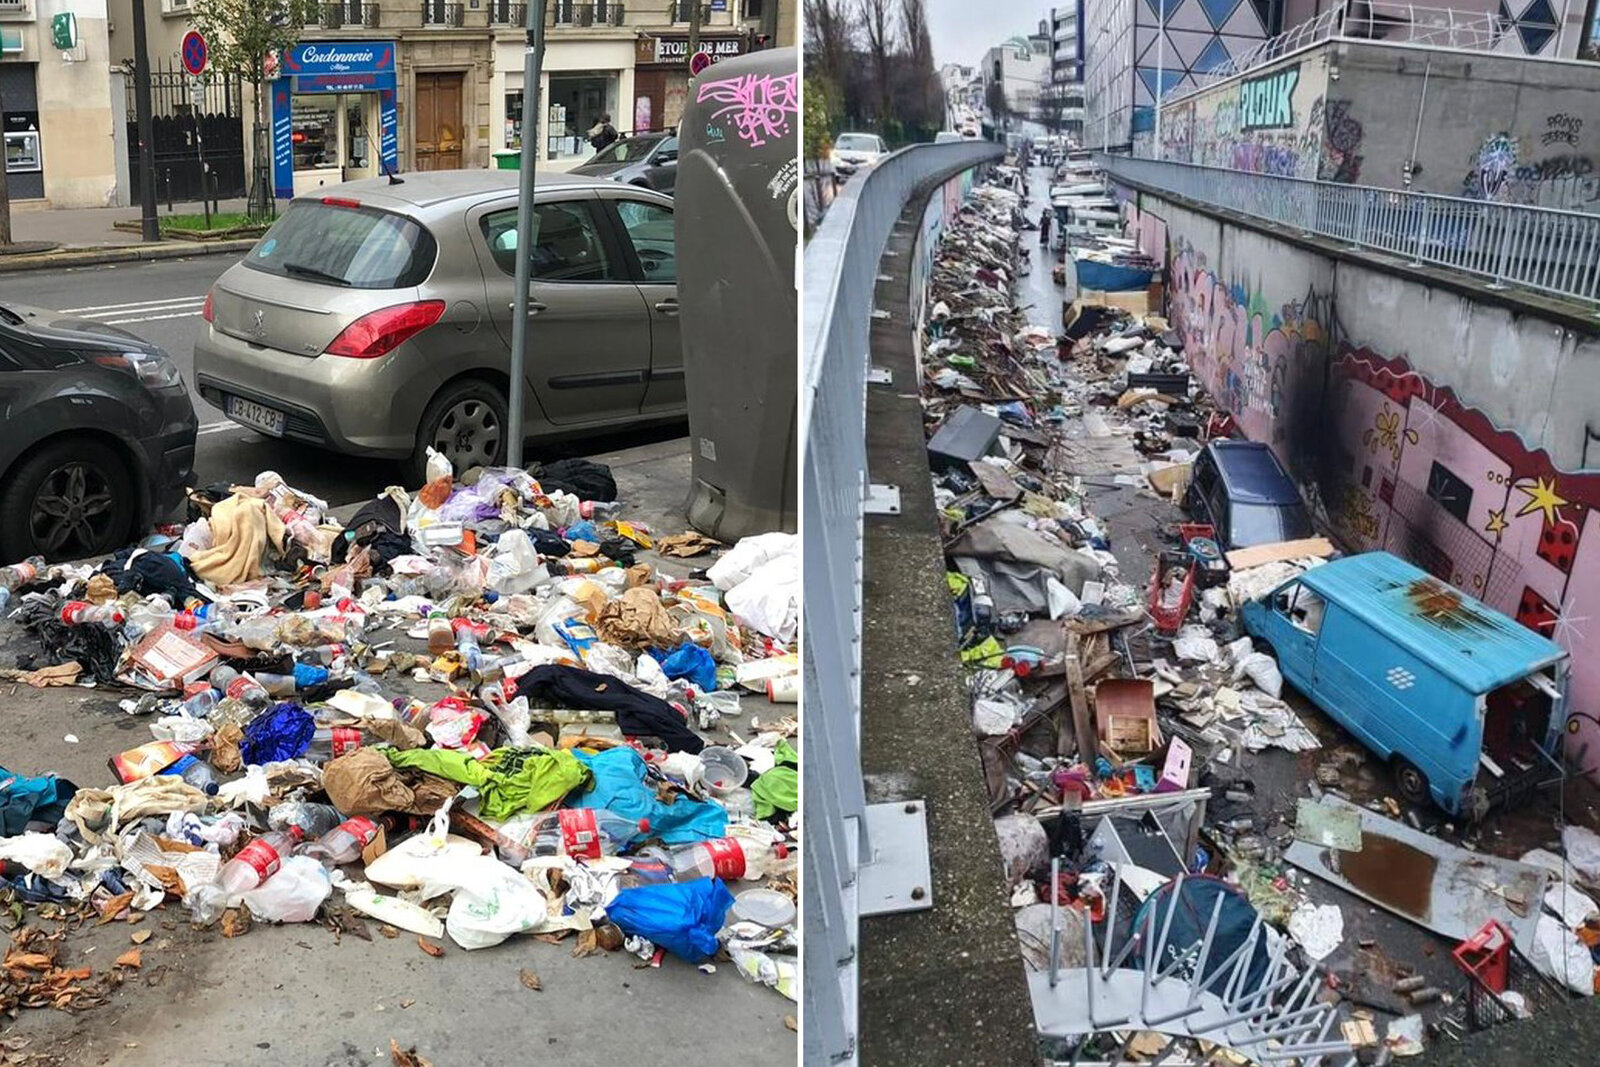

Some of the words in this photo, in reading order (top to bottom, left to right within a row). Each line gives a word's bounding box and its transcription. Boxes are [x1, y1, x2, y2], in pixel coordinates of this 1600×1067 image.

[302, 46, 373, 63] Cordonnerie
[699, 42, 713, 54] DE
[715, 41, 739, 53] MER
[1241, 69, 1299, 130] PLOUK
